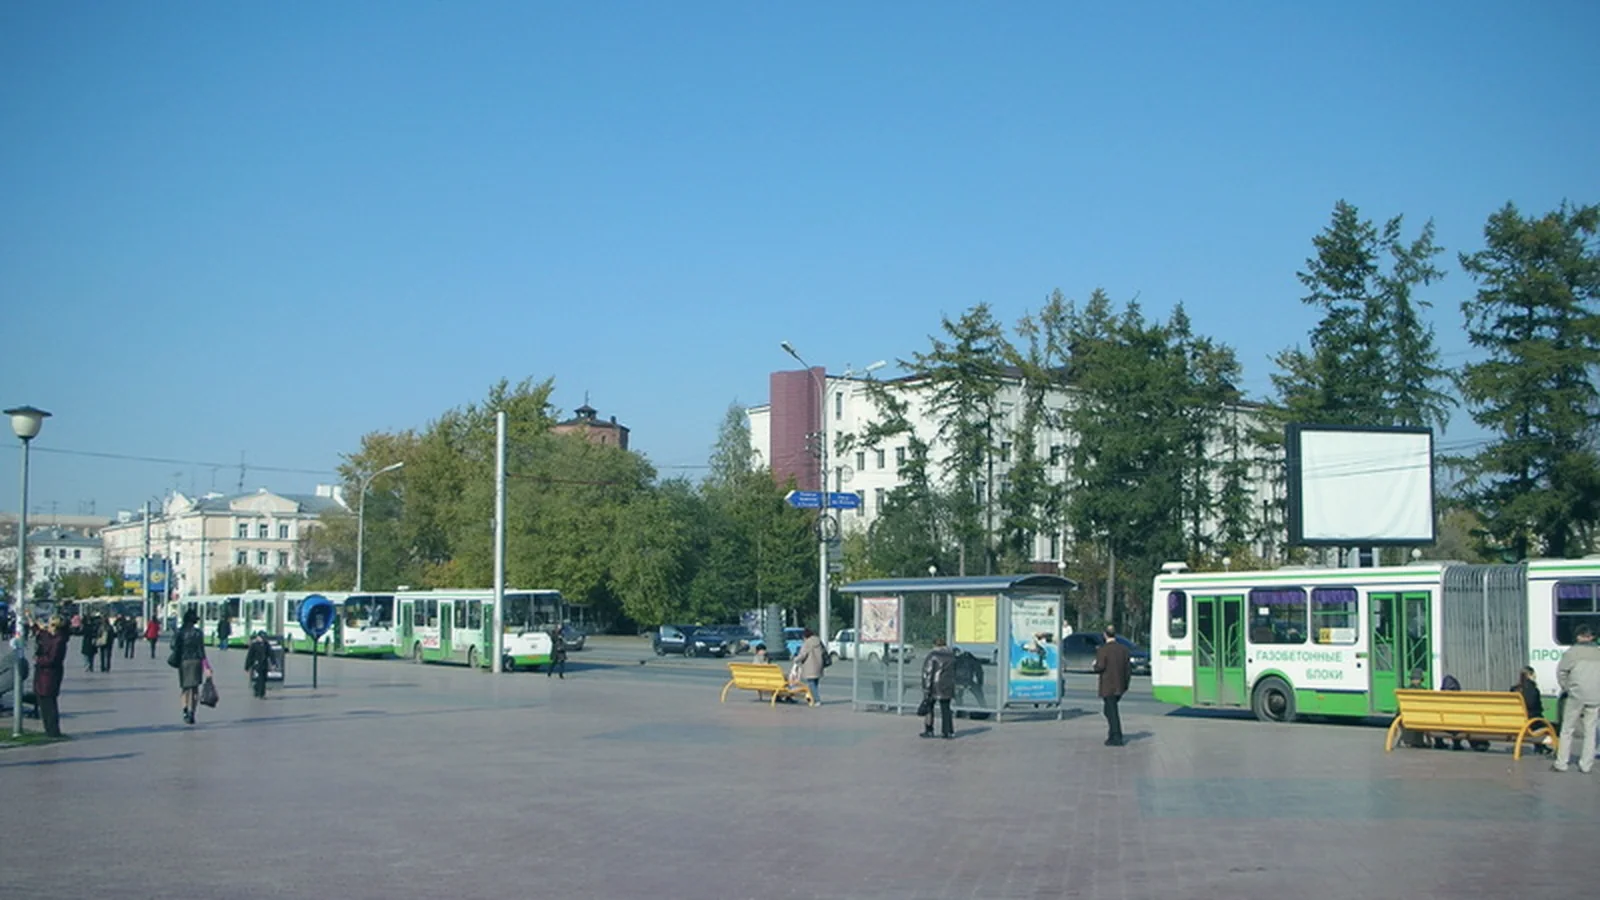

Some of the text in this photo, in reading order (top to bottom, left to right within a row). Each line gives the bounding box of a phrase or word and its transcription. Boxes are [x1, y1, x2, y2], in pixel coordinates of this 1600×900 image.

[1256, 650, 1344, 662] ГАЗОБЕТОННЫЕ
[1531, 649, 1564, 661] ПРО
[1306, 669, 1343, 680] БЛОКИ
